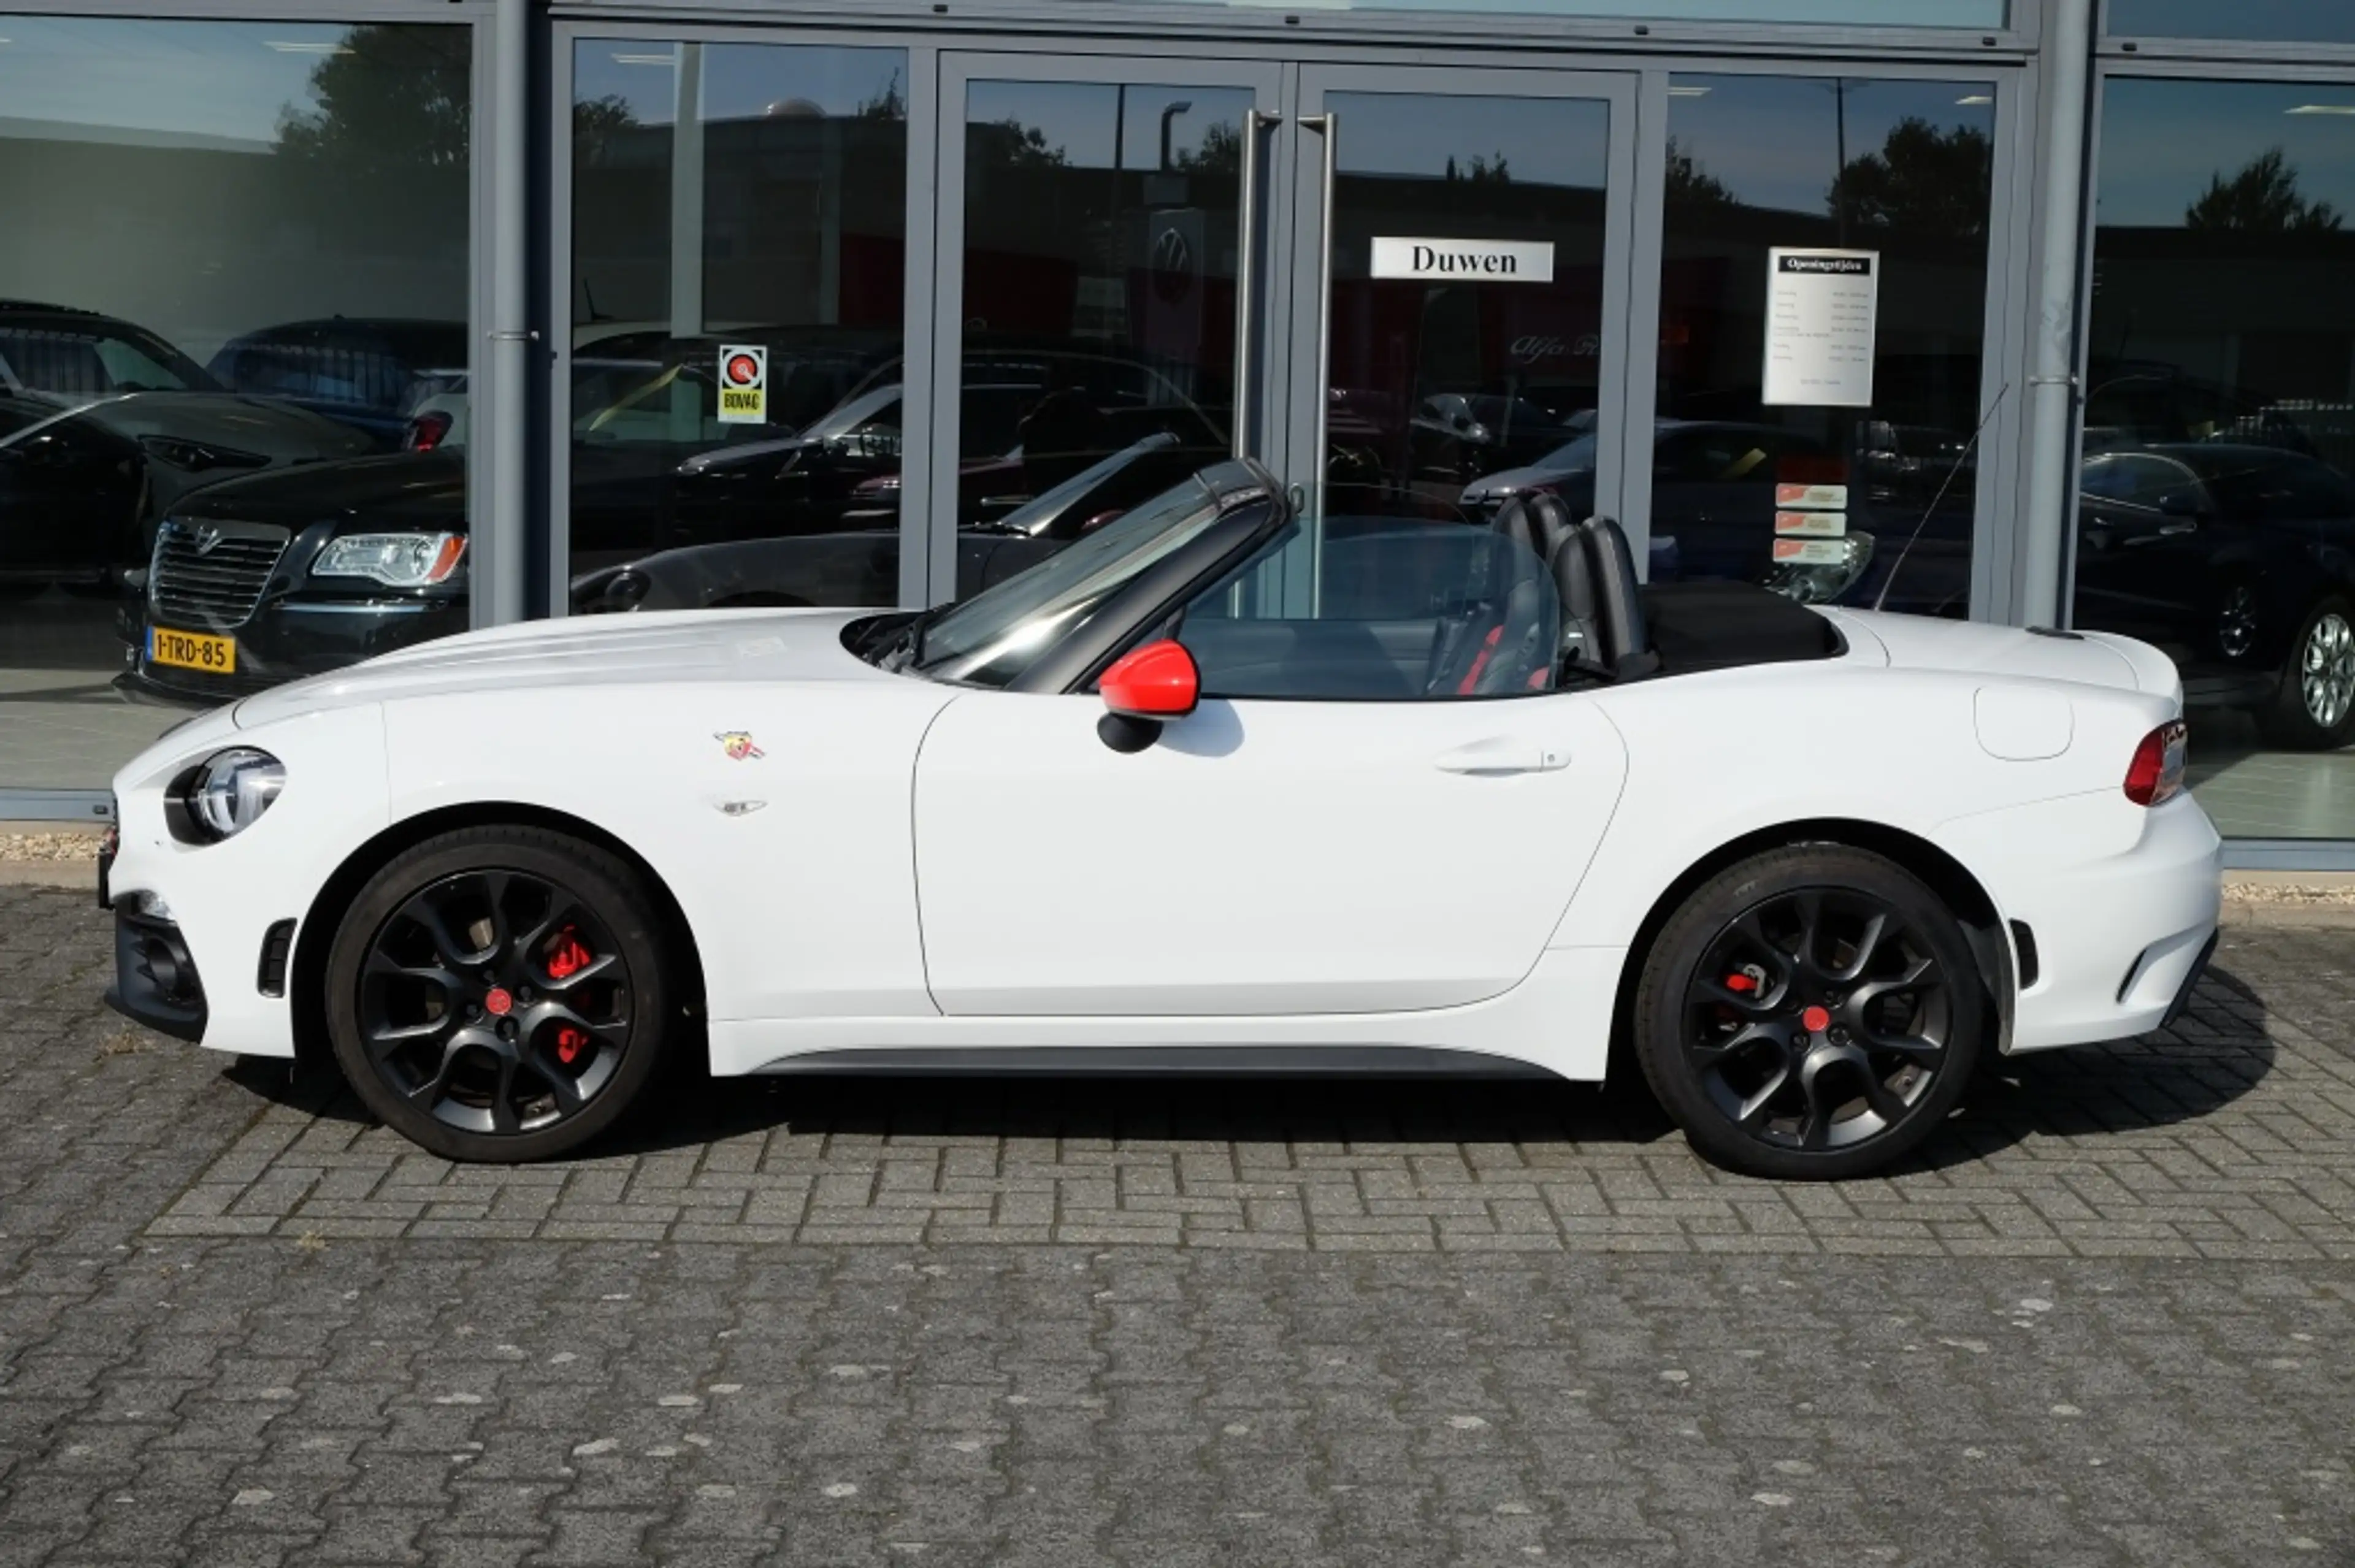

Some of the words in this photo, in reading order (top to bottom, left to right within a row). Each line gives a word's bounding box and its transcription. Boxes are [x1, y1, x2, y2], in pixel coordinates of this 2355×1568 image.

[1412, 245, 1517, 273] Duwen
[1509, 335, 1564, 364] Alfa
[724, 392, 760, 410] BOVAG
[157, 634, 226, 667] 1-TRD-85
